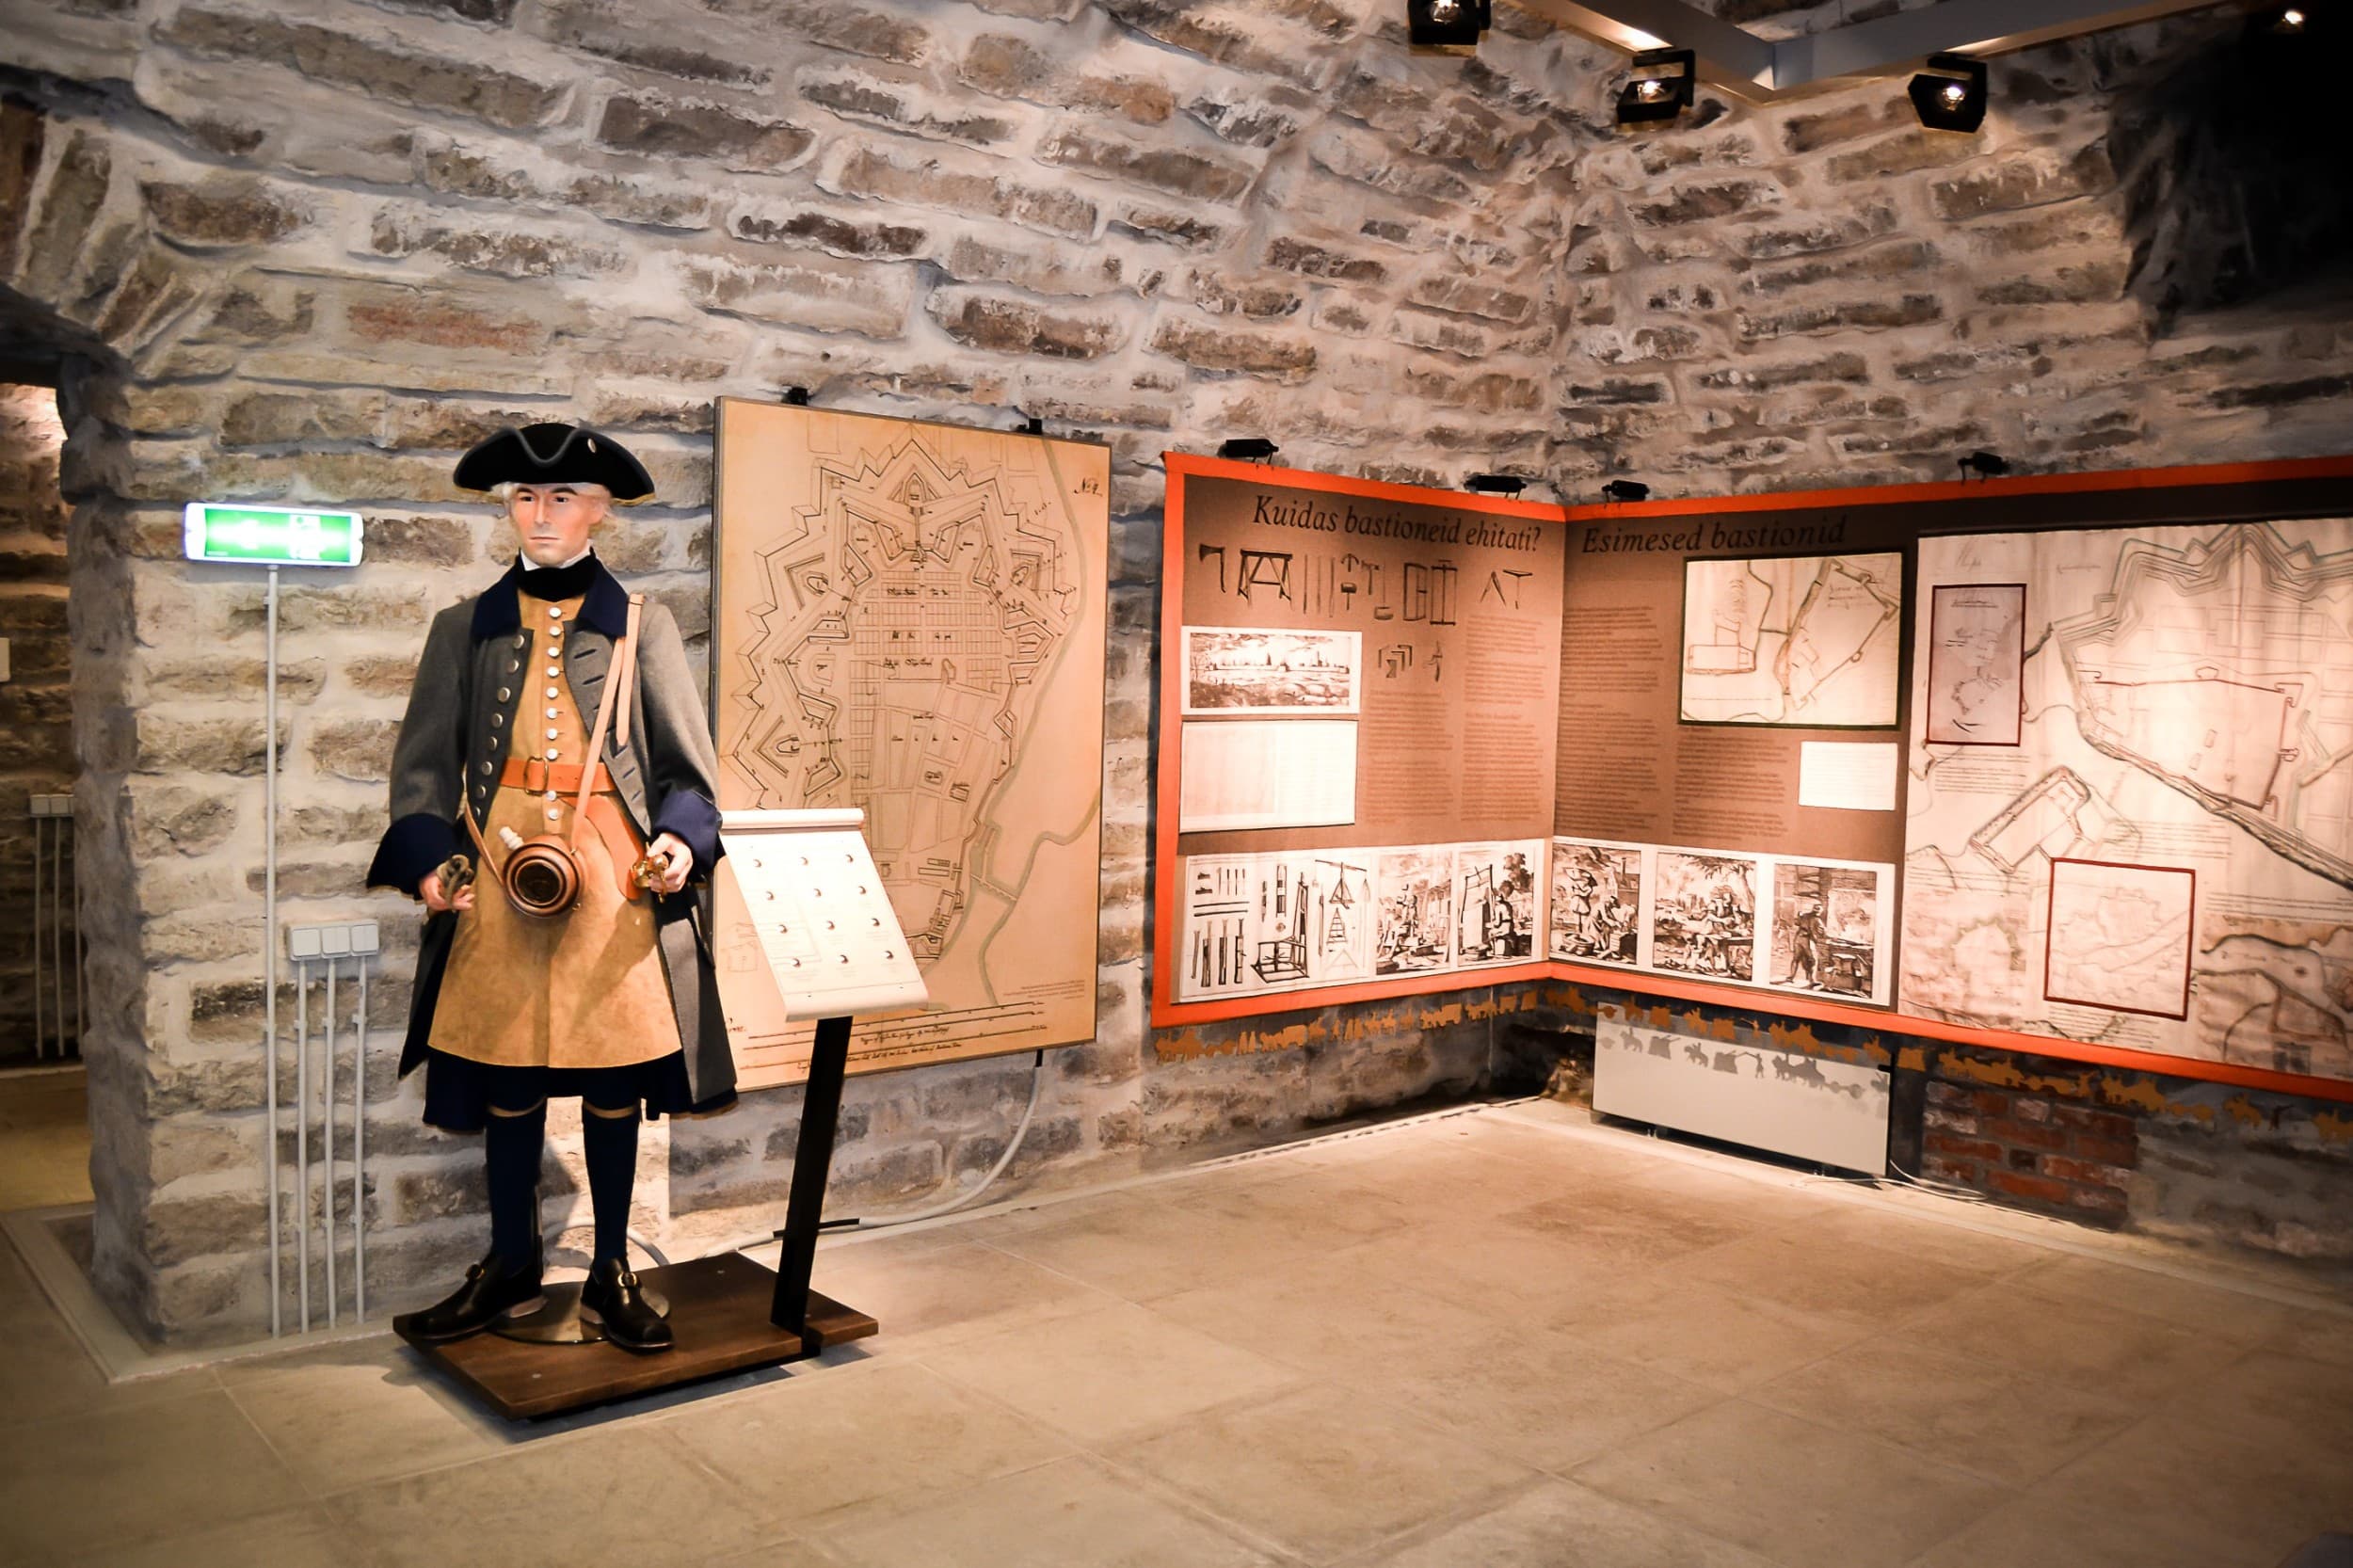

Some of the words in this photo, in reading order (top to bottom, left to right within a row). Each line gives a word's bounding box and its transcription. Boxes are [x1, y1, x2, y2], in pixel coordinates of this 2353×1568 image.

[1253, 494, 1338, 533] Kuidas
[1344, 504, 1462, 544] bastioneid
[1465, 520, 1542, 552] ehitati?
[1582, 523, 1703, 553] Esimesed
[1711, 515, 1848, 551] bastionid
